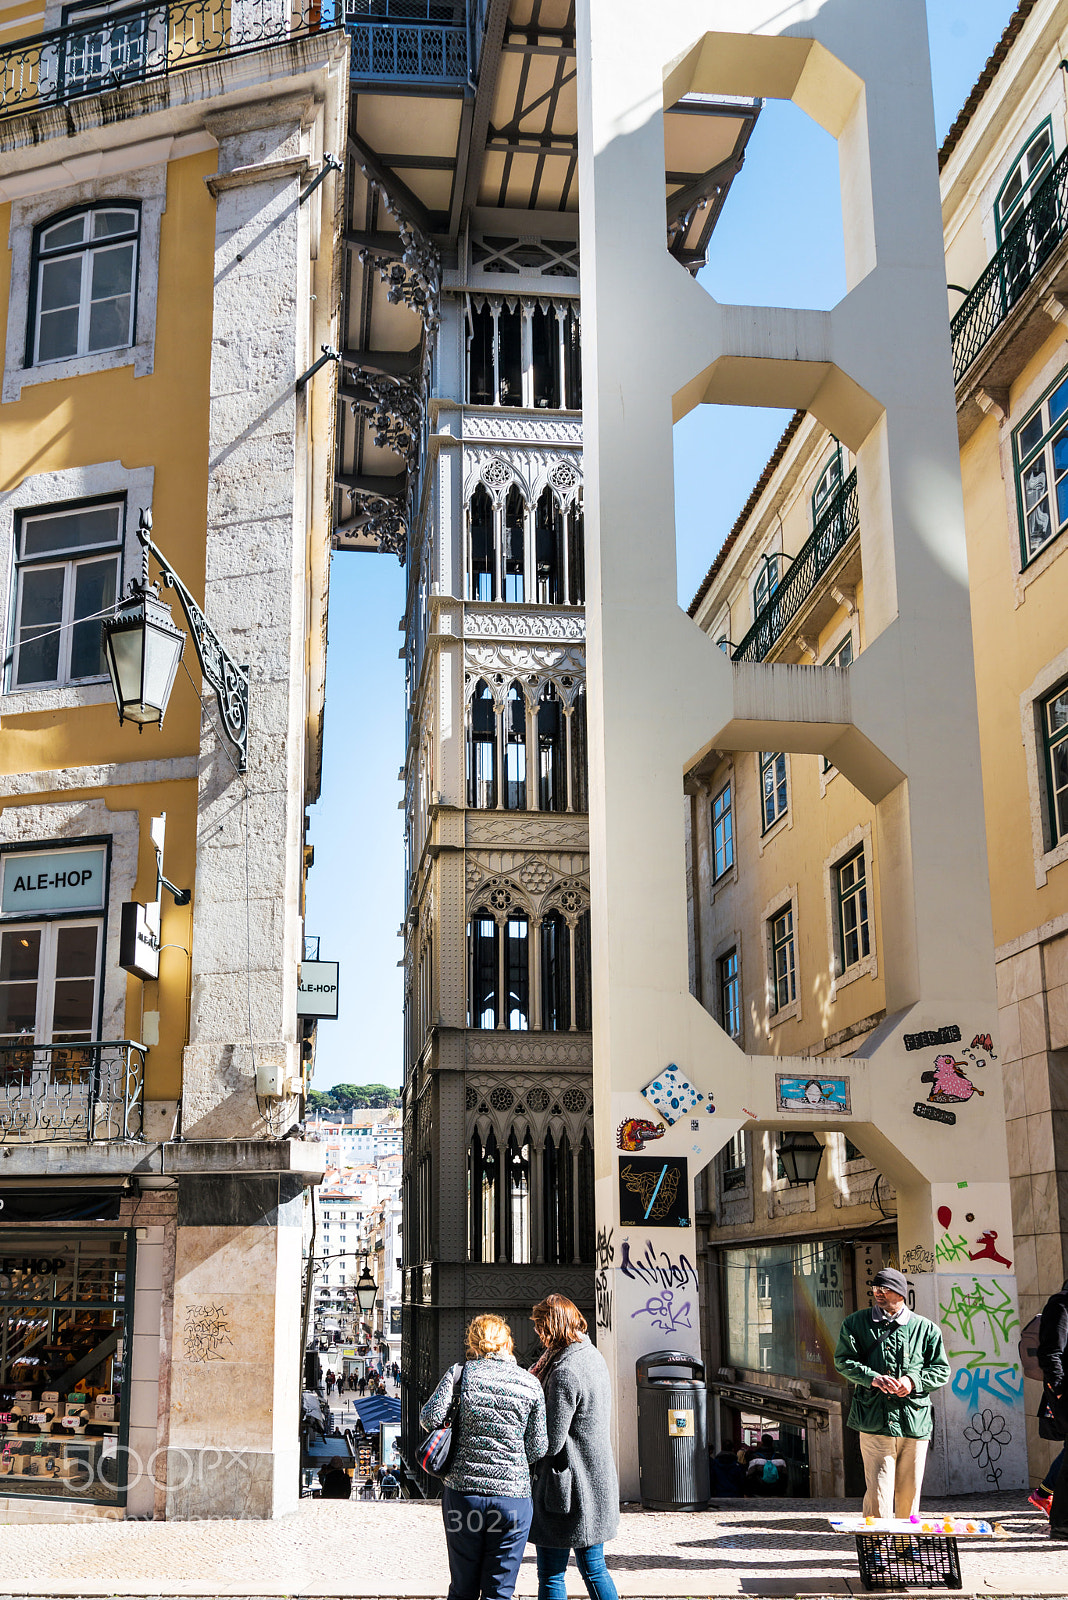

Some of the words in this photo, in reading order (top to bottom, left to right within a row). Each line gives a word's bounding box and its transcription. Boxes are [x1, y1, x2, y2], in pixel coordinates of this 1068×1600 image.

[13, 869, 92, 892] ALE-HOP
[819, 1264, 838, 1288] 45
[816, 1289, 844, 1308] MINUTOS
